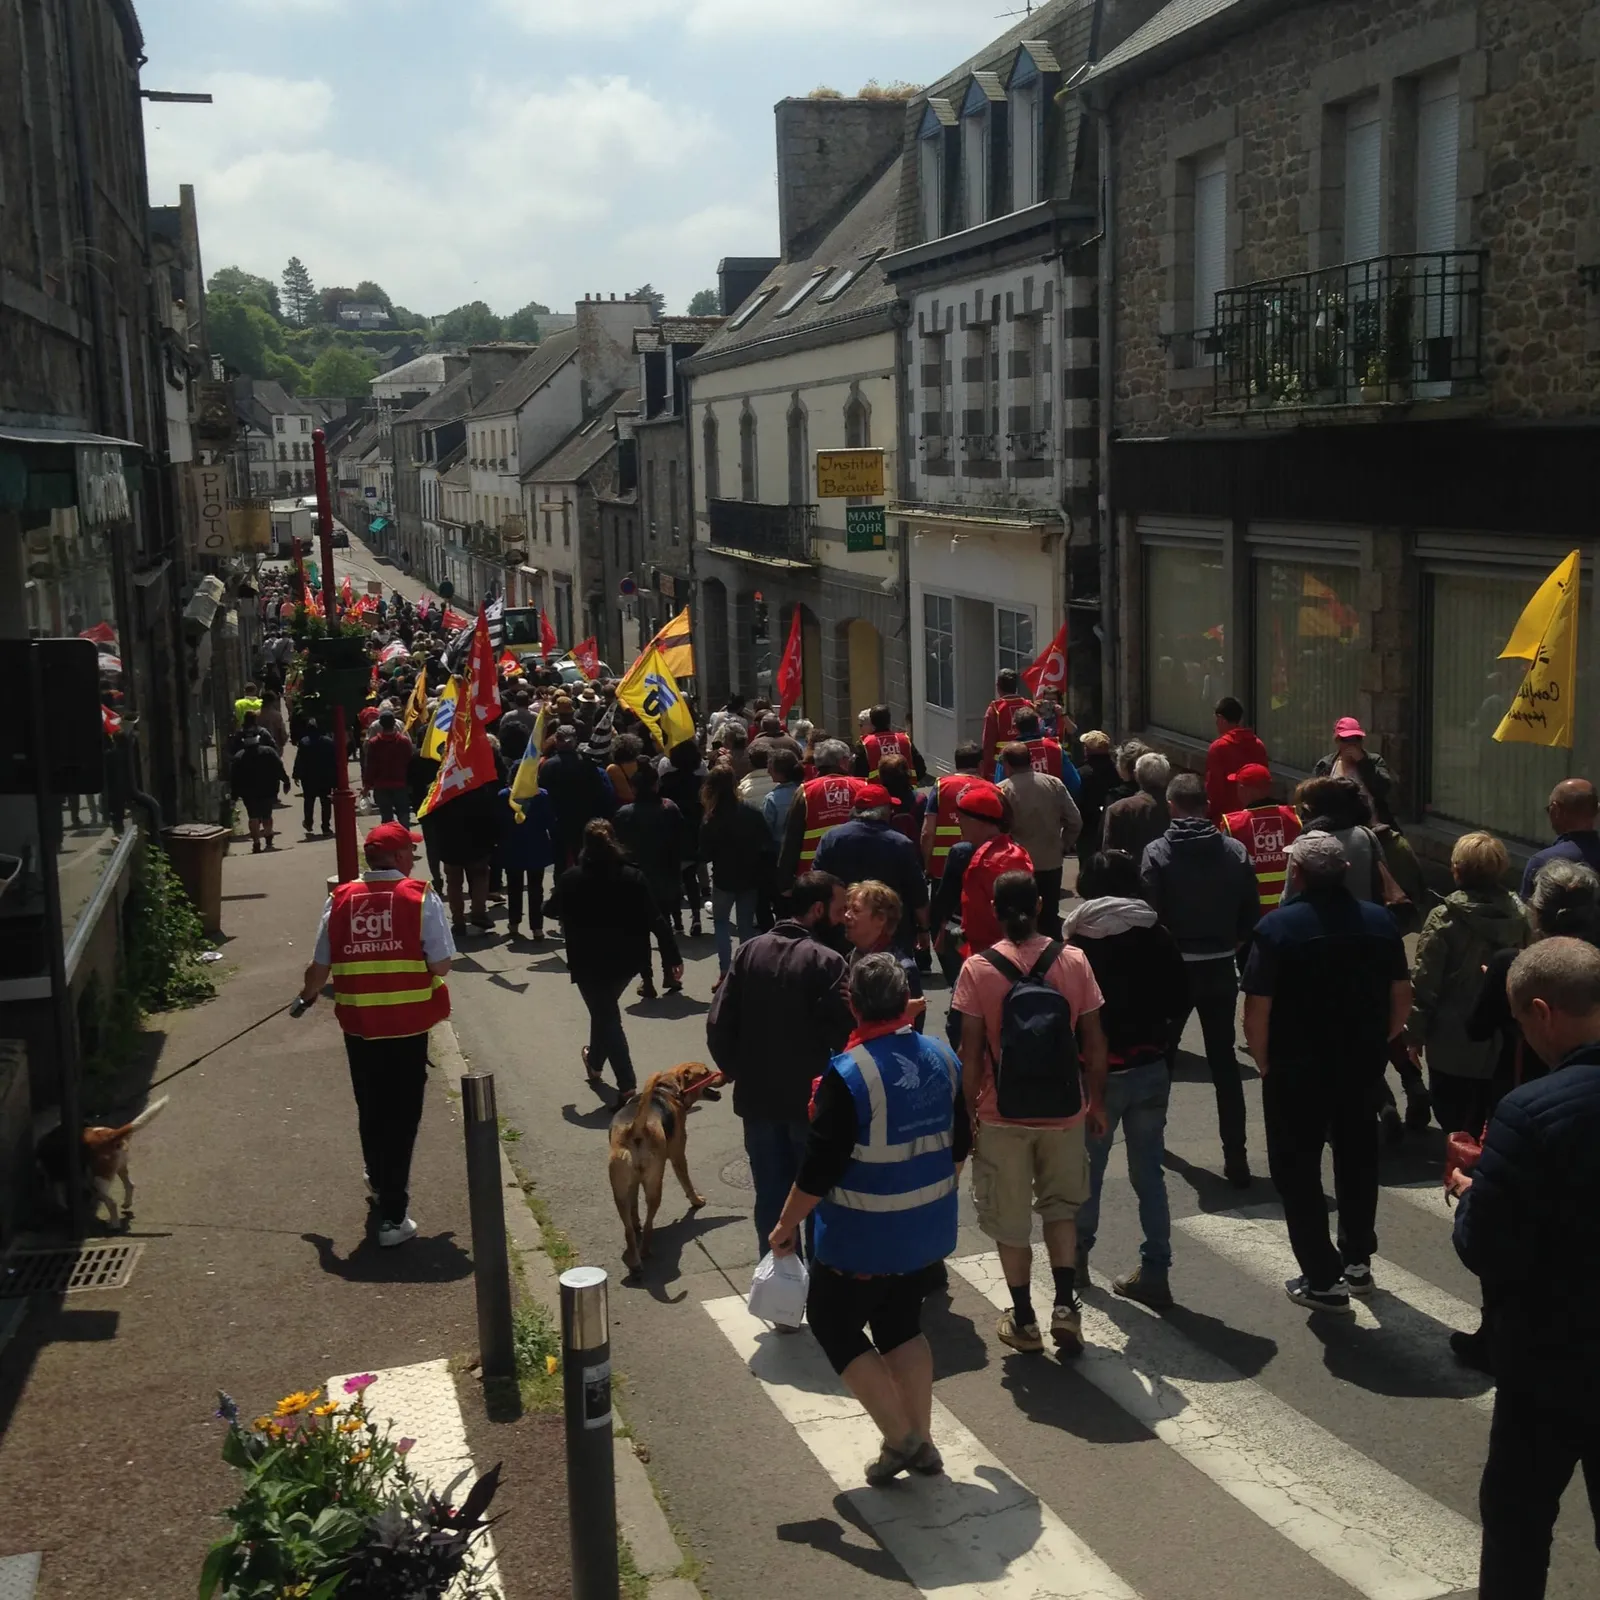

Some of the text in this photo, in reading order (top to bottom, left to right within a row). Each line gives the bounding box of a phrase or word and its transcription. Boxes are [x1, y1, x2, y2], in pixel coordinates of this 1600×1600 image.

[821, 456, 879, 471] Institut
[823, 479, 878, 493] Beauté
[201, 472, 224, 549] PHOTO
[848, 511, 883, 521] MARY
[848, 523, 883, 533] COHR
[880, 742, 901, 755] cgt
[1031, 756, 1049, 773] gt
[827, 788, 850, 804] cgt
[1254, 829, 1285, 852] cgt
[351, 909, 392, 938] cgt
[343, 940, 403, 954] CARHAIX
